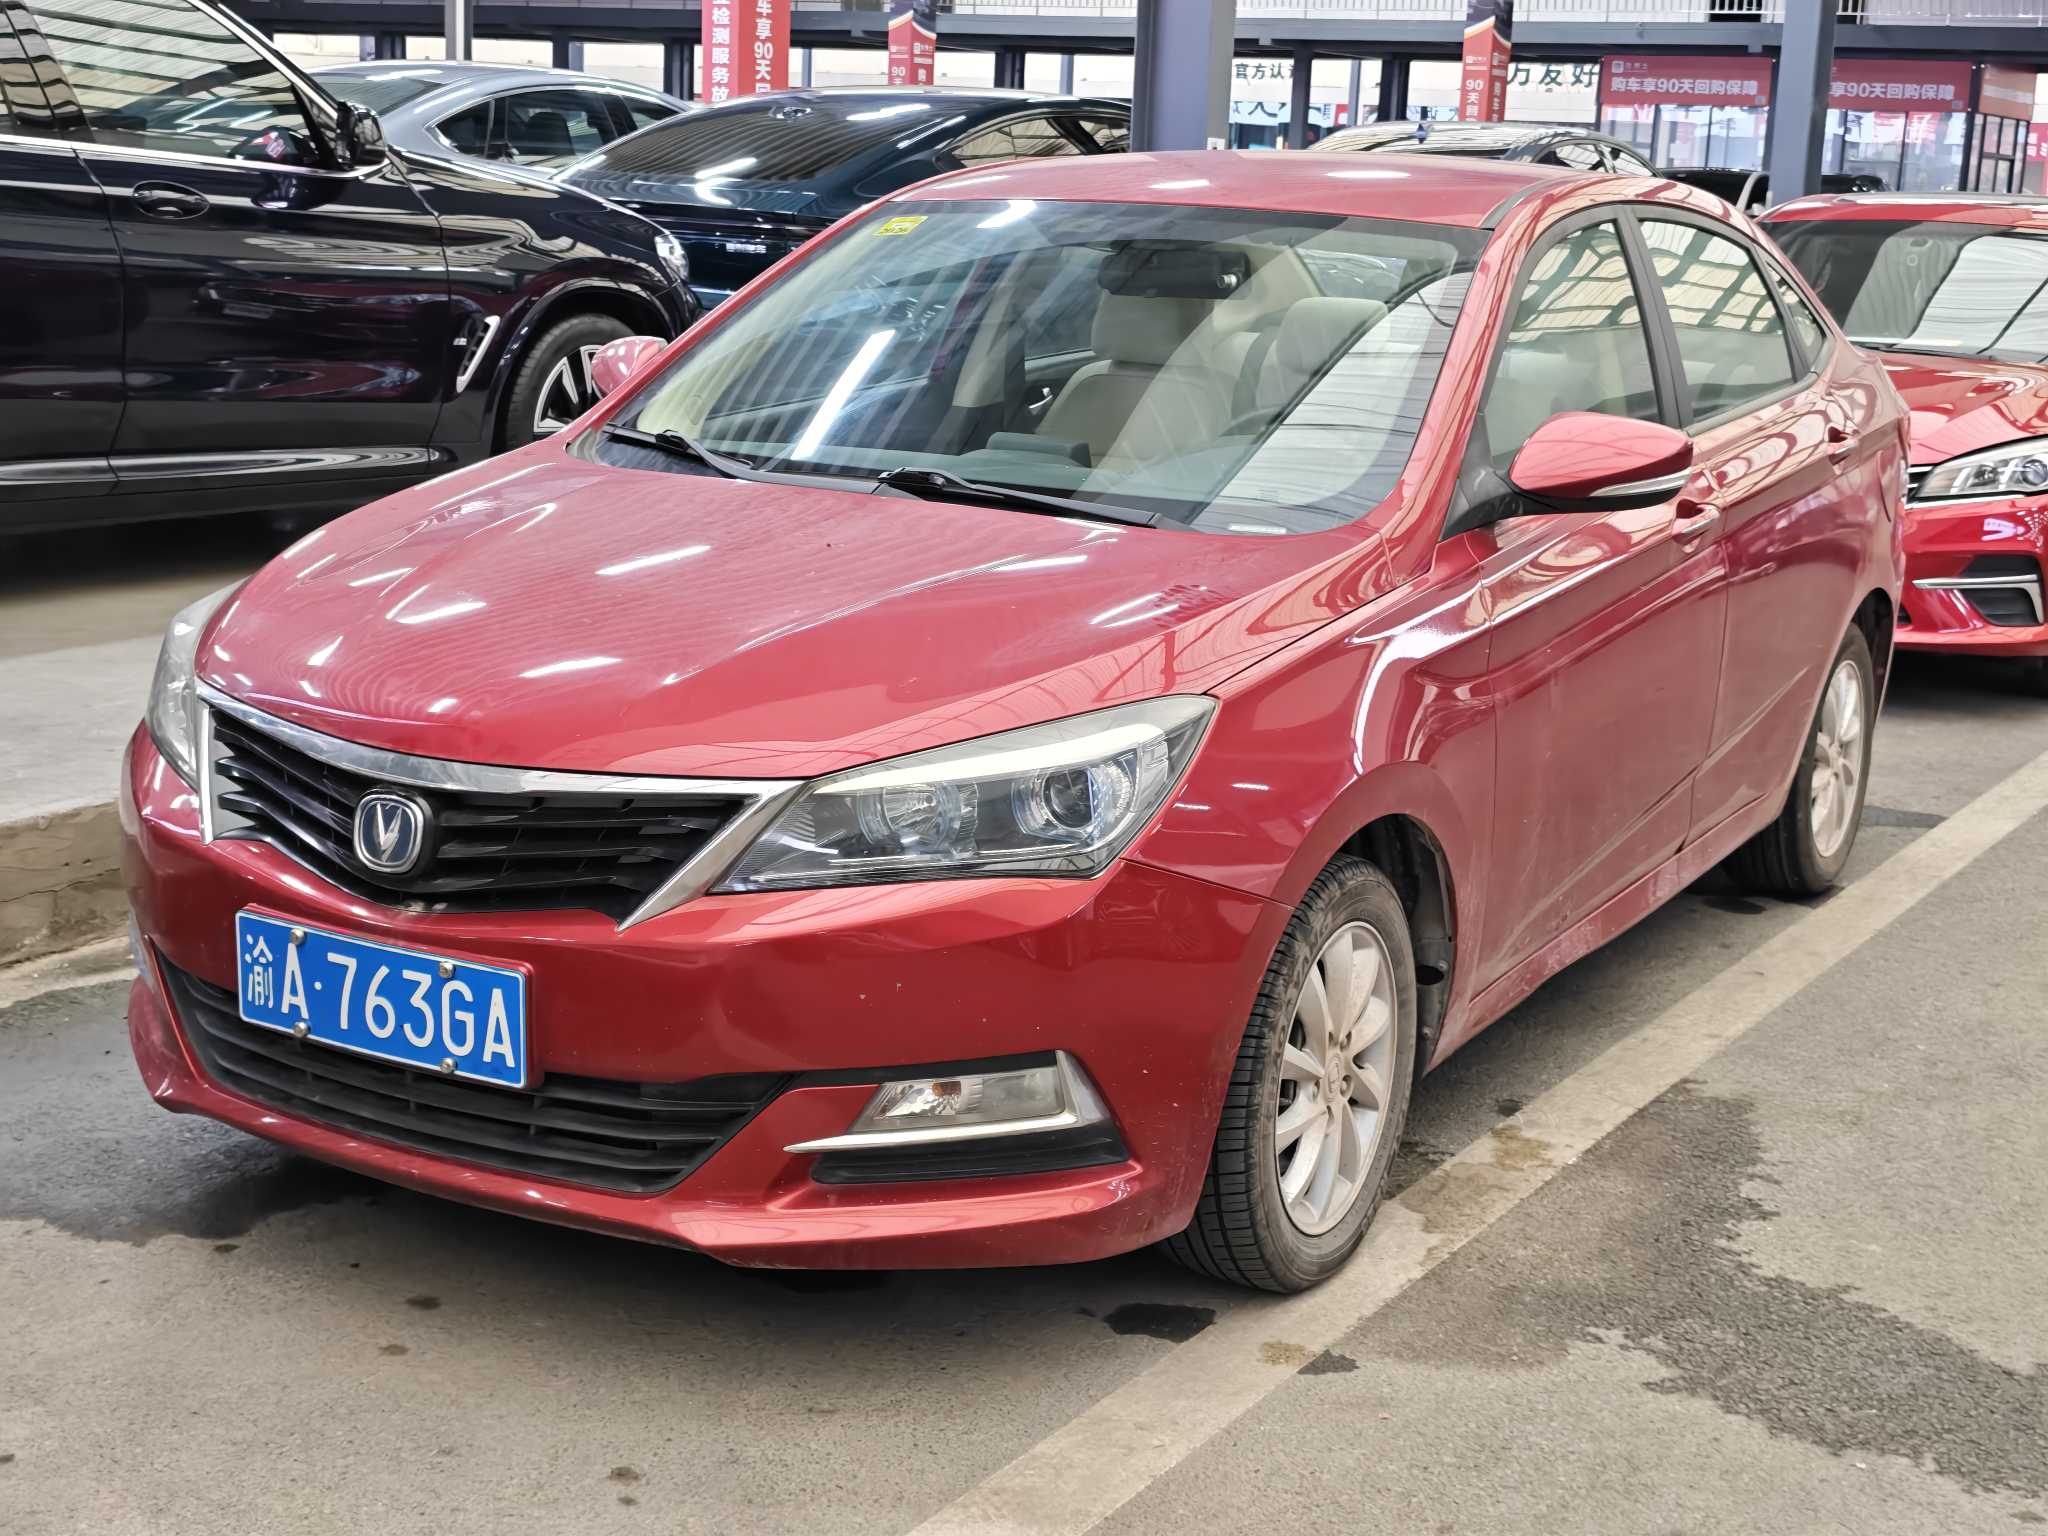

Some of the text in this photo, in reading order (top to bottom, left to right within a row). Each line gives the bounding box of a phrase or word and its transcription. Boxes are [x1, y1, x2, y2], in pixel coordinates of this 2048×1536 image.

[712, 0, 730, 101] 检测服务放
[1611, 77, 1759, 96] 购车享90天回购保障
[245, 934, 516, 1068] 渝A·763GA
